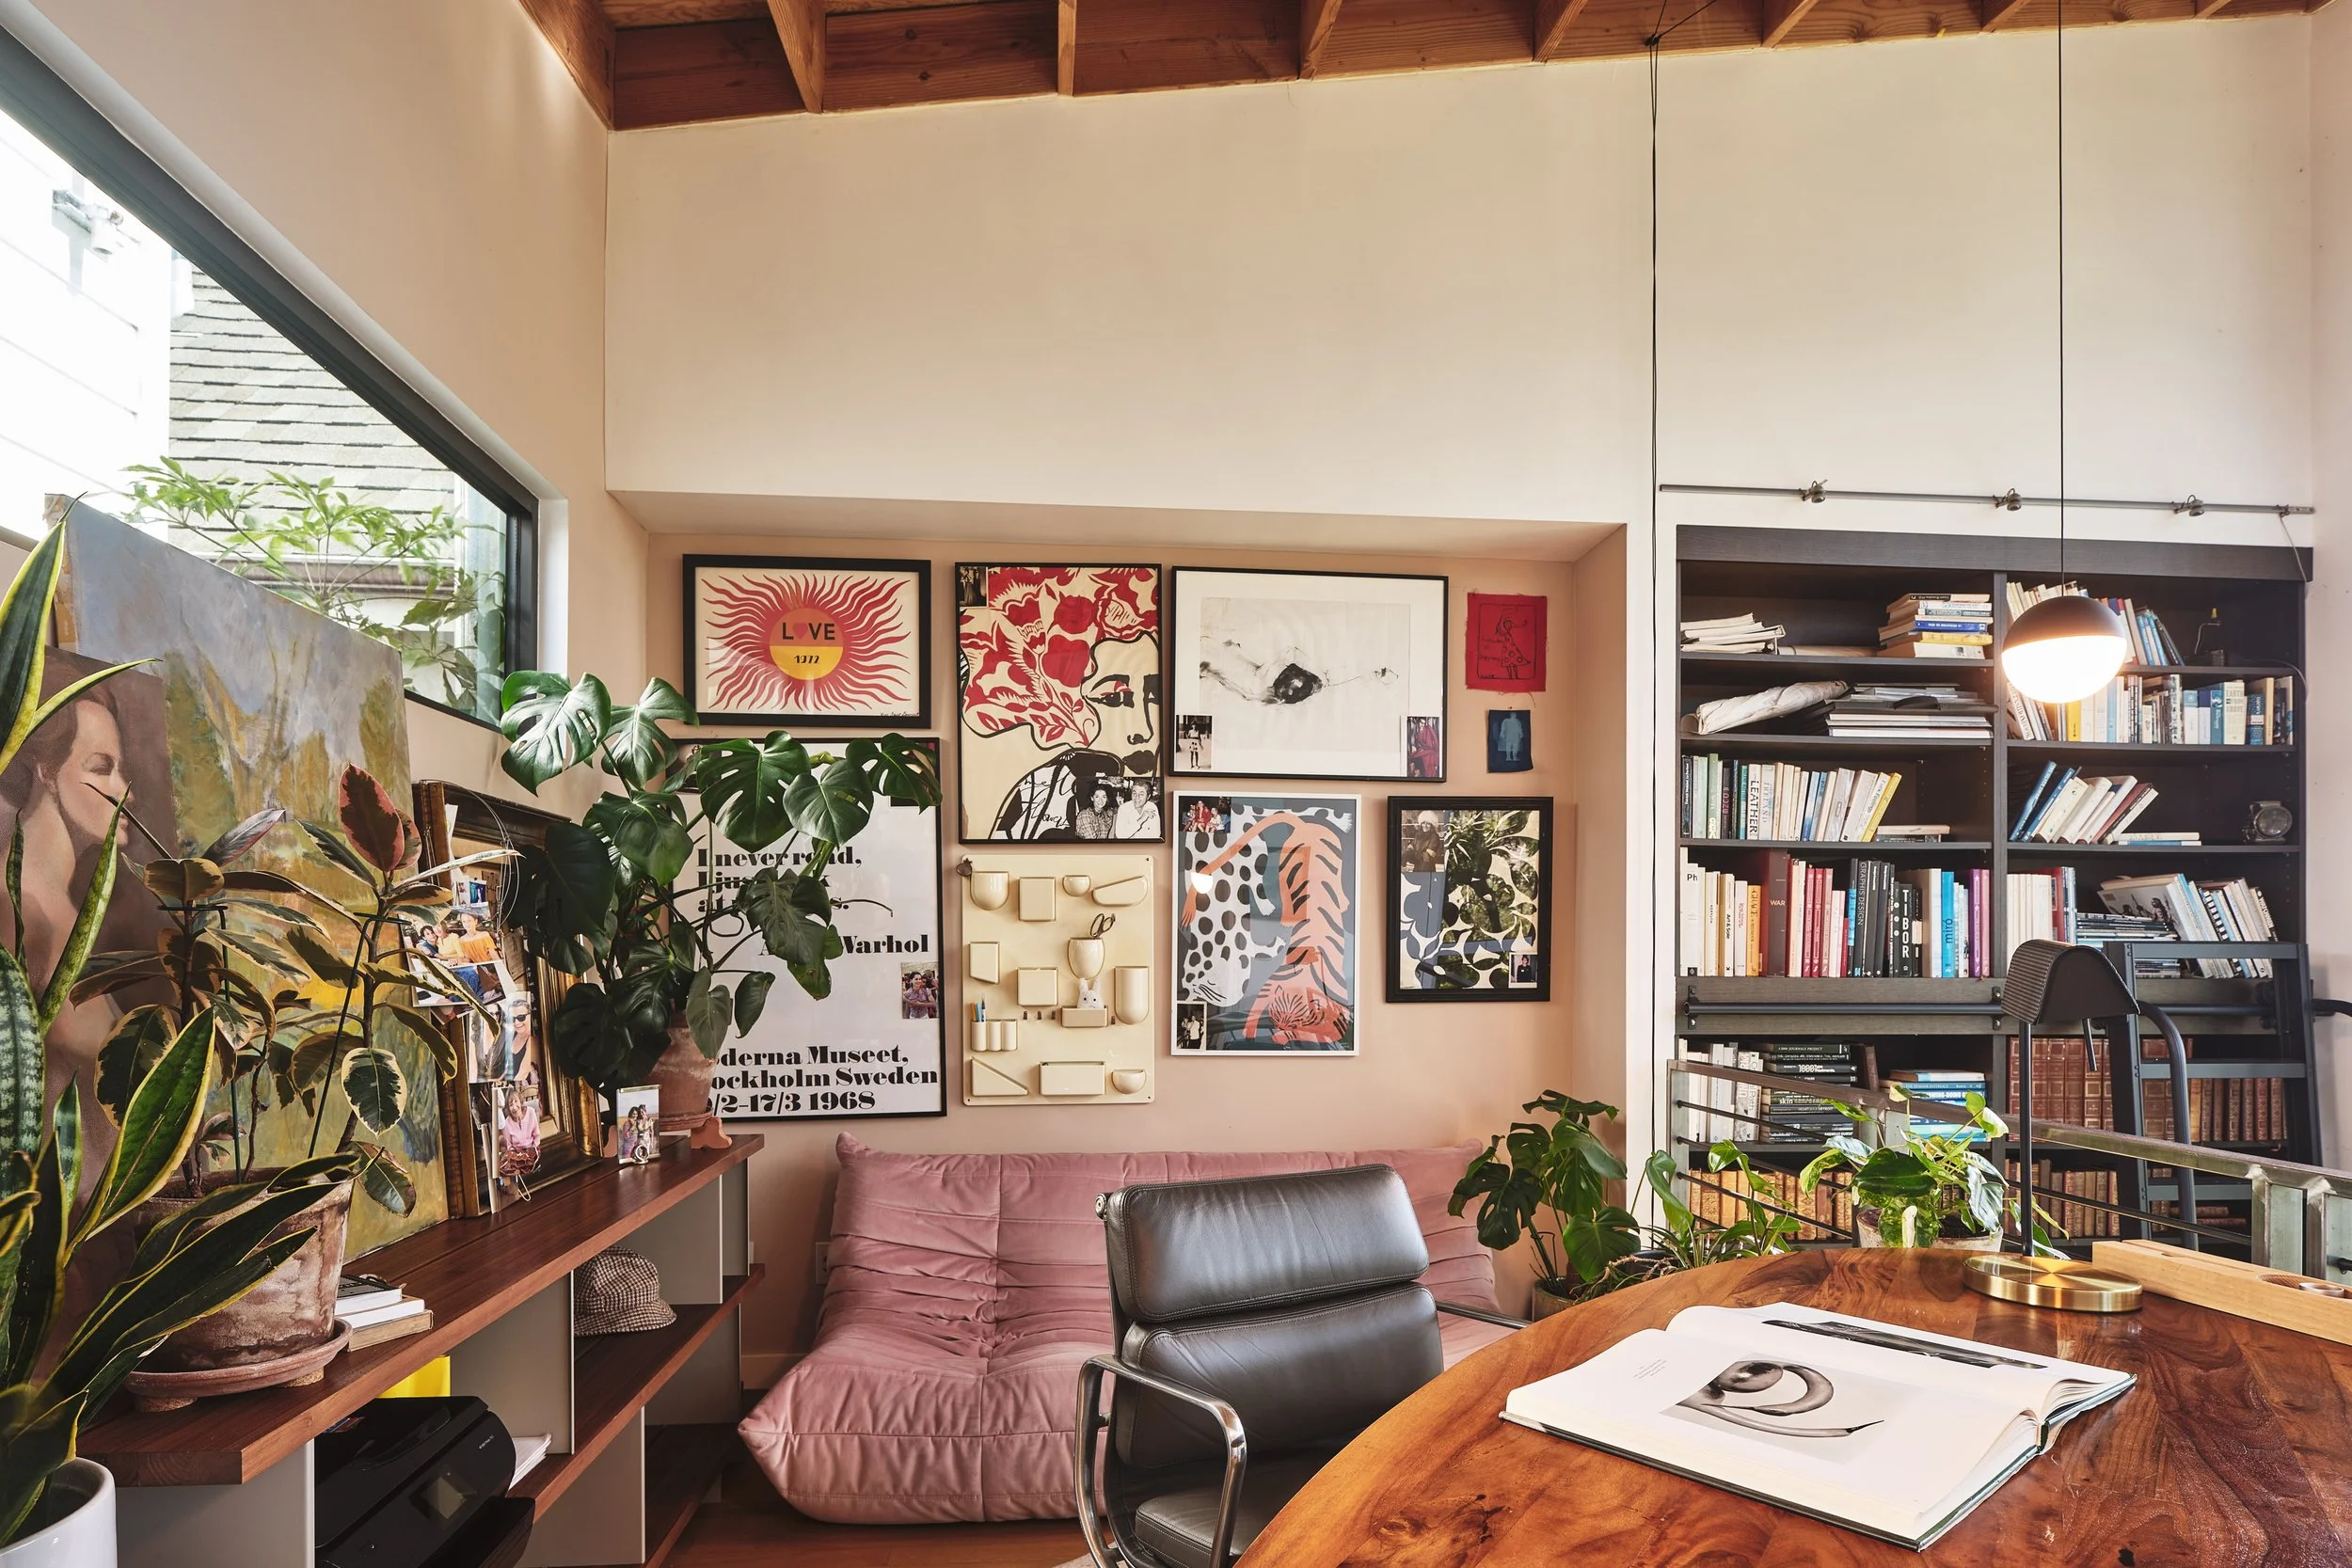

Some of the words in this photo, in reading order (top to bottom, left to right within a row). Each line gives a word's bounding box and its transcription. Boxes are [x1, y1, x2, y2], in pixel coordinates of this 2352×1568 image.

[793, 655, 820, 664] 1972
[1750, 780, 1759, 833] LEATHER
[1867, 792, 1880, 813] Feelings
[698, 848, 708, 867] I
[715, 853, 788, 866] never
[2258, 897, 2274, 928] WATCHMEN
[1943, 918, 1953, 944] miró
[838, 934, 929, 954] Warhol
[716, 1048, 803, 1066] derna
[807, 1044, 909, 1066] Museet,
[711, 1069, 831, 1090] ockholm
[835, 1066, 938, 1087] Sweden
[1798, 1064, 1814, 1072] 1000
[808, 1090, 875, 1111] 1968
